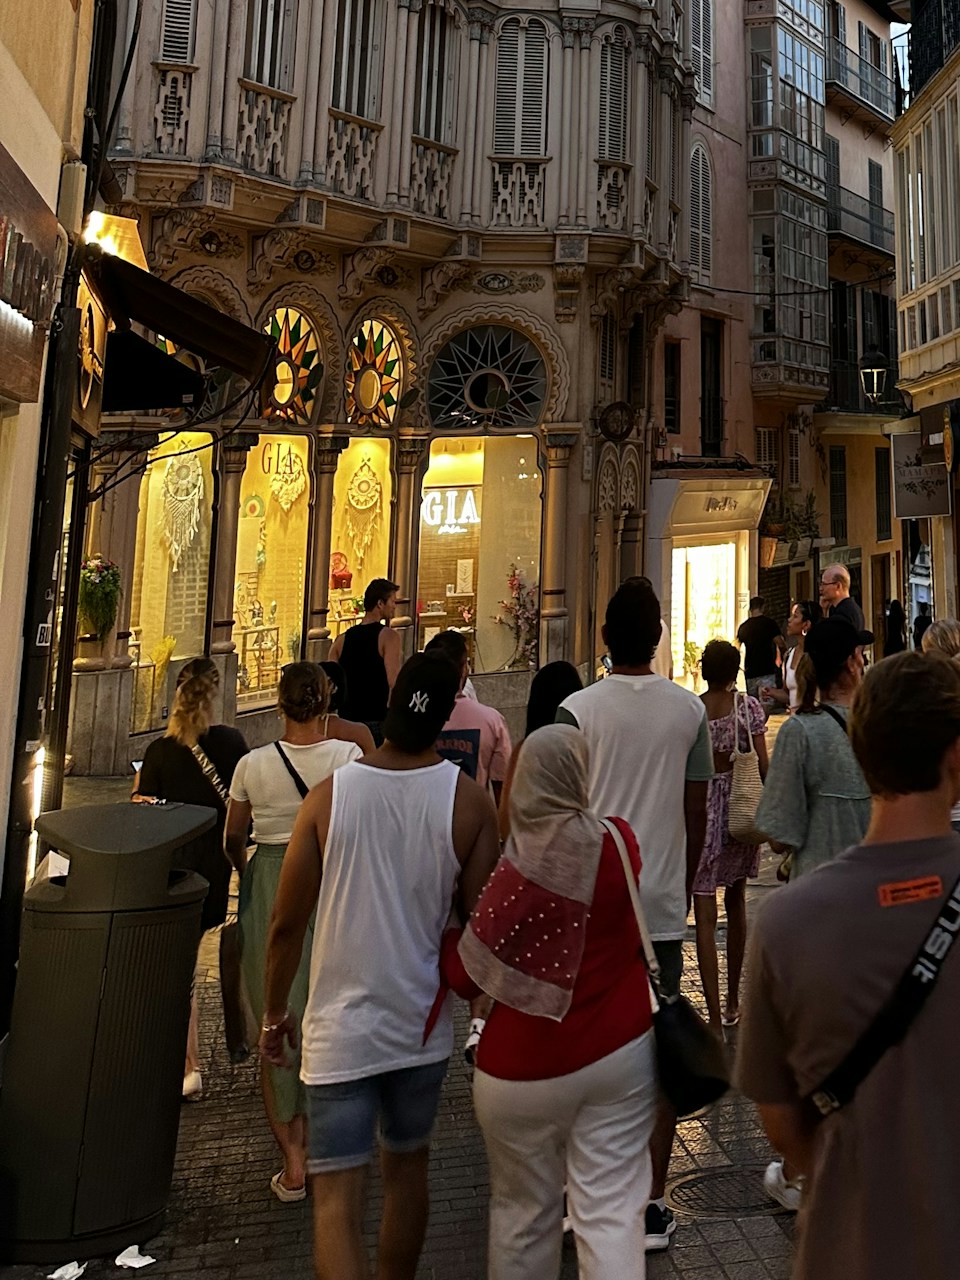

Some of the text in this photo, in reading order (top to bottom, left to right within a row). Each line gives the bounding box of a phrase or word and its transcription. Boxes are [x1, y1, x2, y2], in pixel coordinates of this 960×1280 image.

[261, 442, 295, 475] GIA
[422, 489, 481, 526] GIA
[408, 690, 429, 713] NY
